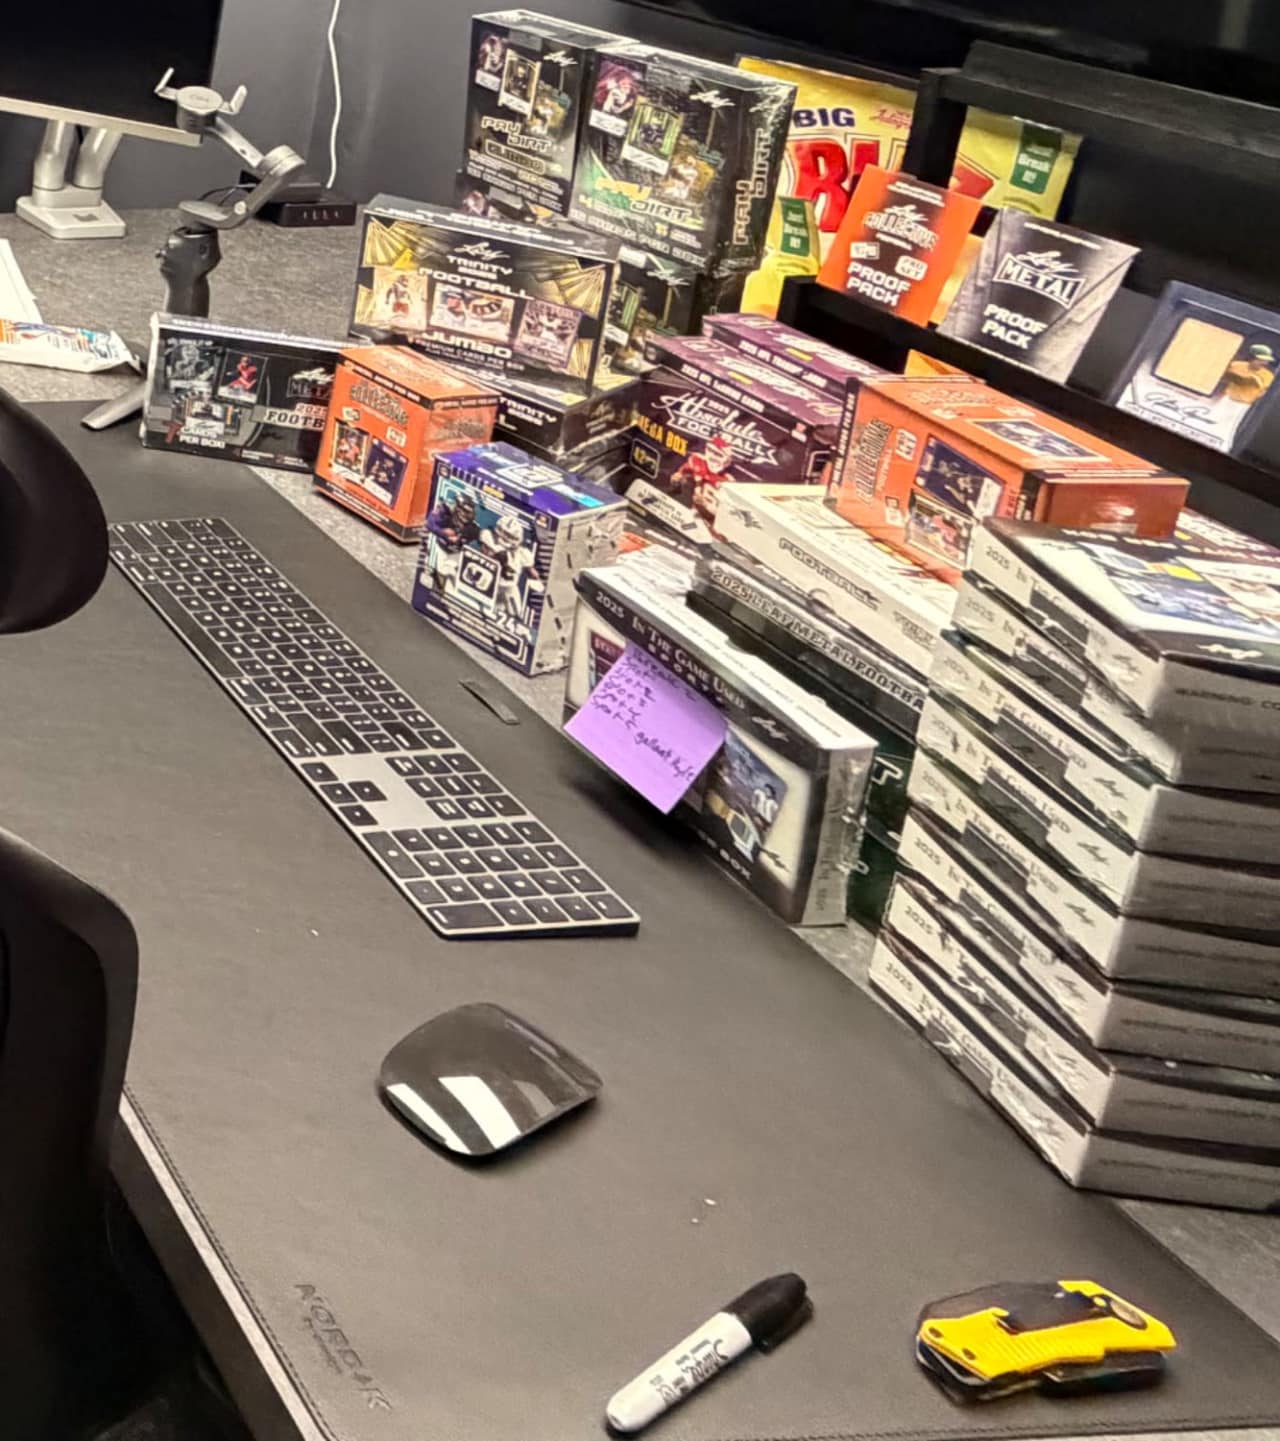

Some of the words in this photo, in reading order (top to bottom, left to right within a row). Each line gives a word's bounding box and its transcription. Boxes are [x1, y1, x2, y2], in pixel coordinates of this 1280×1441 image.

[793, 108, 856, 128] BIG
[446, 255, 513, 276] TRINITY
[847, 261, 911, 293] PROOF
[417, 268, 535, 301] FOOTBALL
[846, 279, 901, 307] PACK
[1001, 262, 1077, 307] METAL
[983, 304, 1048, 336] PROOF
[981, 320, 1033, 350] PACK
[265, 413, 326, 430] FOOTB
[666, 432, 689, 456] BOX
[595, 590, 626, 619] 2025
[850, 656, 926, 712] FOOTBA
